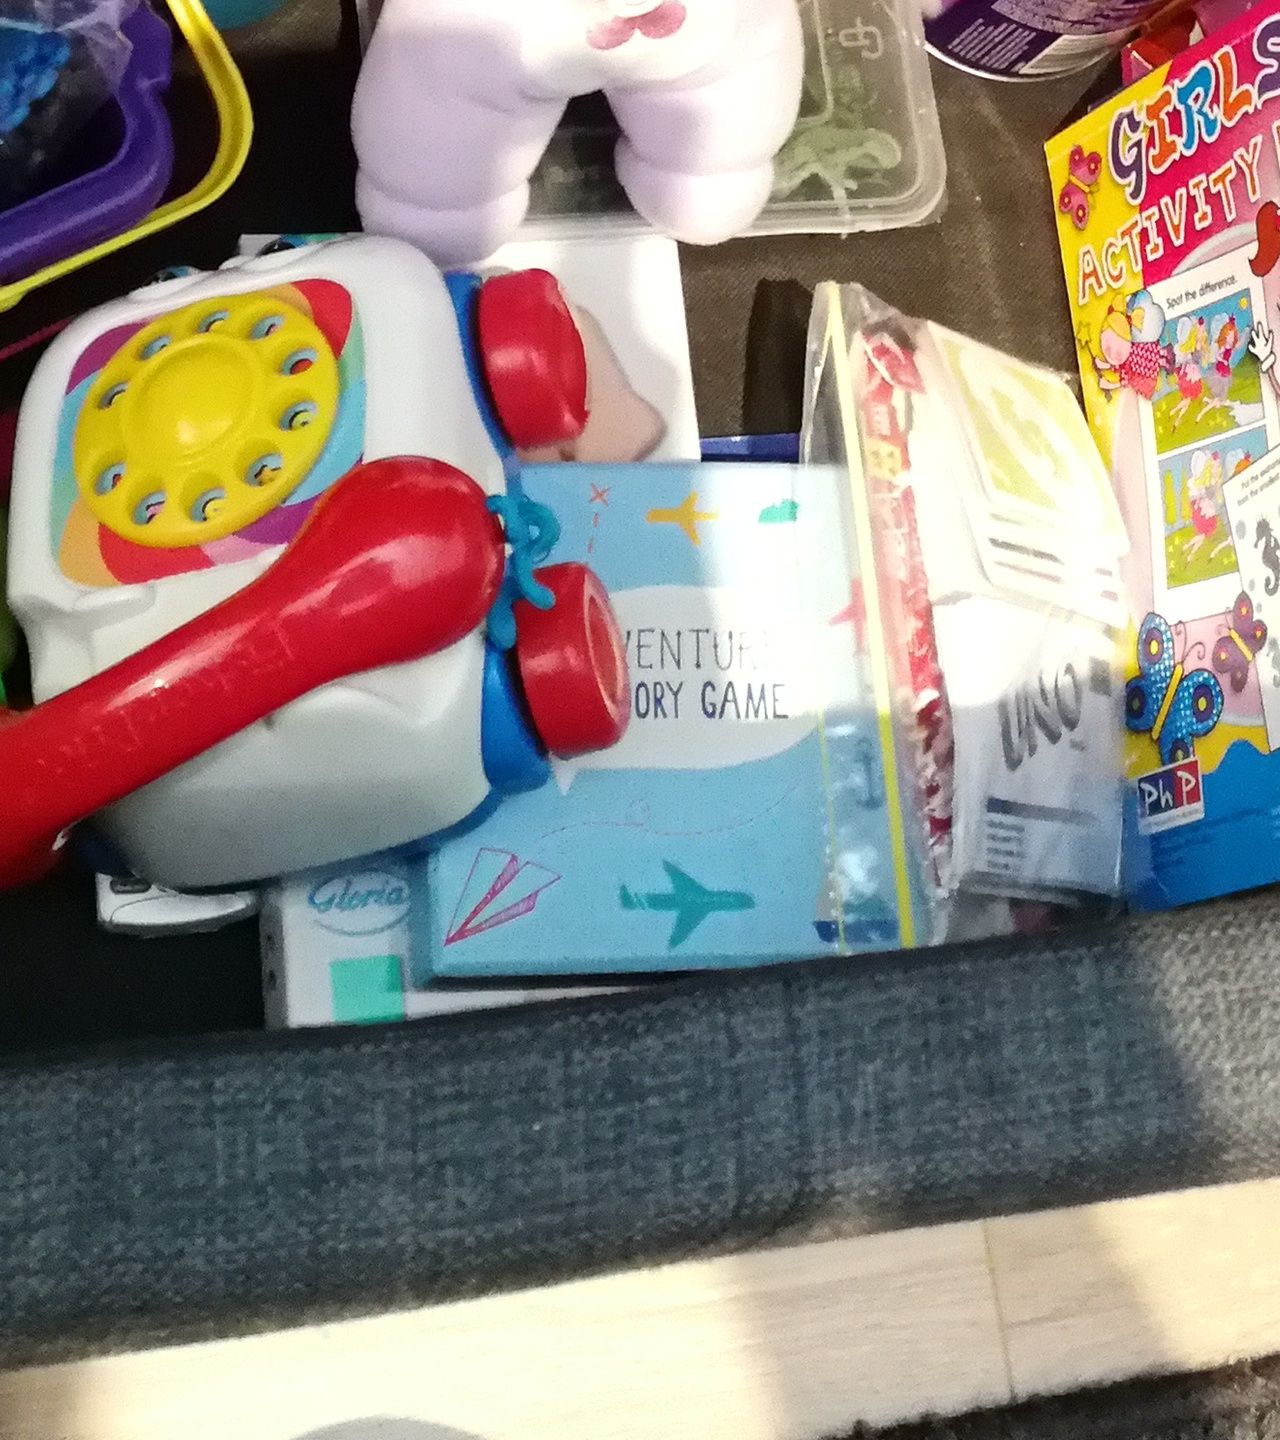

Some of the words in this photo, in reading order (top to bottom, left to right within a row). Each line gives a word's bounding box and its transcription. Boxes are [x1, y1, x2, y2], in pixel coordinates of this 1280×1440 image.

[1077, 136, 1264, 305] ACTIVITY
[624, 627, 766, 671] ENTUR
[634, 680, 684, 720] ORY
[700, 680, 789, 720] GAME
[998, 662, 1082, 771] UNO
[1140, 769, 1197, 816] PhP
[307, 876, 406, 913] Gloria
